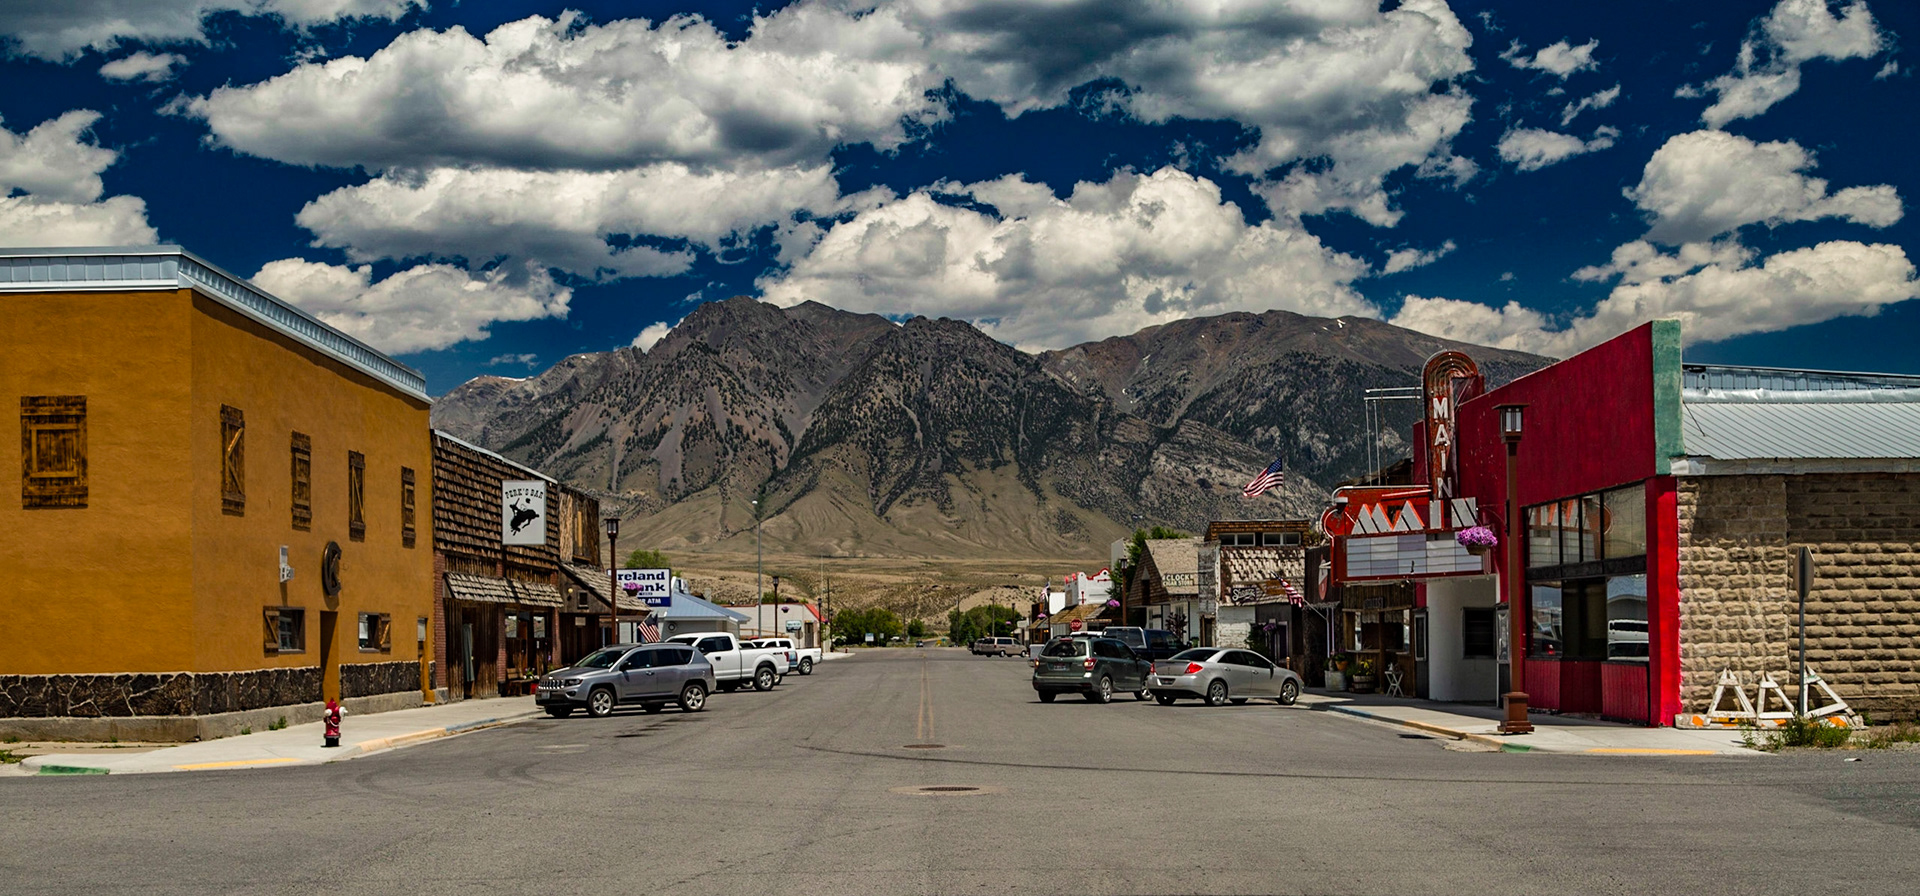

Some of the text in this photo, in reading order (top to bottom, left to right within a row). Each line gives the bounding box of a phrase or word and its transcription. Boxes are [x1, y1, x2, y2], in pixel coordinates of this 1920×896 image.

[1433, 398, 1452, 498] MAIN
[505, 488, 544, 499] PERK'S BAR
[1351, 497, 1478, 534] MAIN
[617, 572, 666, 581] reland
